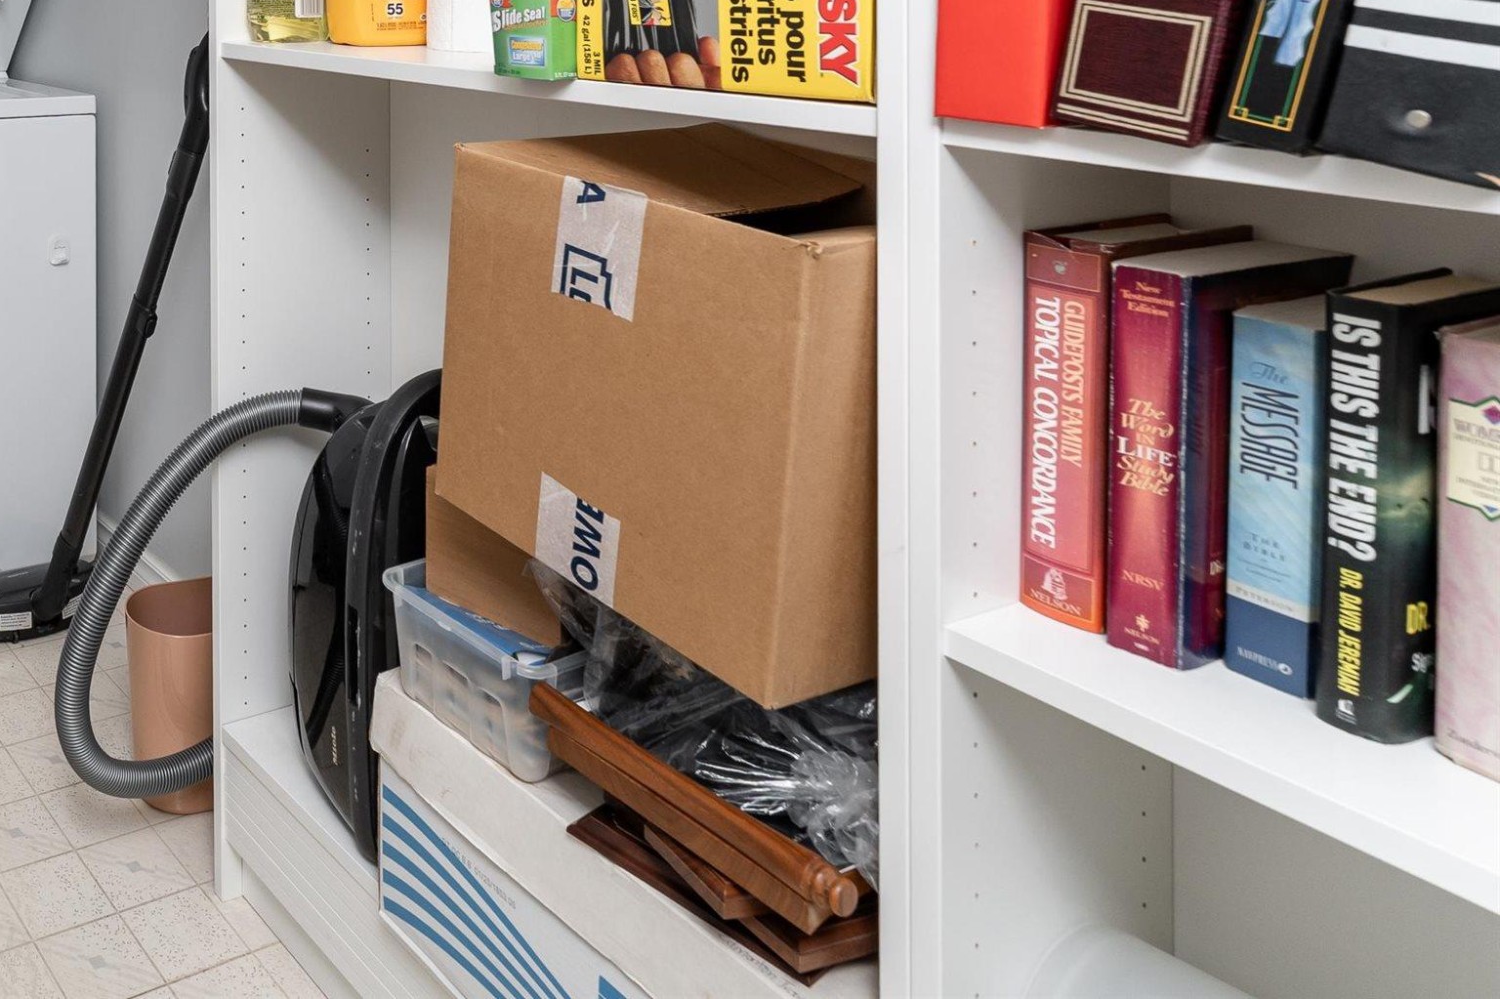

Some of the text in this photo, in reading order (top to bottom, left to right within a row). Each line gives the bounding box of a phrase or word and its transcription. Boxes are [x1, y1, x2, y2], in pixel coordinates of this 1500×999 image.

[387, 3, 404, 15] 55
[491, 8, 523, 33] Slide
[523, 6, 546, 21] Seal
[581, 14, 591, 27] 42
[581, 28, 591, 42] gal
[778, 8, 806, 83] pour
[582, 44, 592, 65] (158
[593, 60, 601, 76] MIL
[1119, 288, 1175, 307] Testament
[1135, 281, 1163, 294] New
[1126, 301, 1170, 318] Edition
[1248, 361, 1288, 384] The
[1061, 301, 1085, 468] GUIDEPOSTS FAMILY
[1129, 398, 1166, 420] The
[1031, 296, 1061, 550] TOPICAL CONCORDANCE
[1240, 382, 1300, 490] MESSAGE
[1327, 312, 1382, 562] IS THIS THE END?
[1116, 435, 1176, 467] LIFE
[1119, 470, 1170, 497] Bible
[1336, 566, 1364, 697] DR. DAVID JEREMIAH
